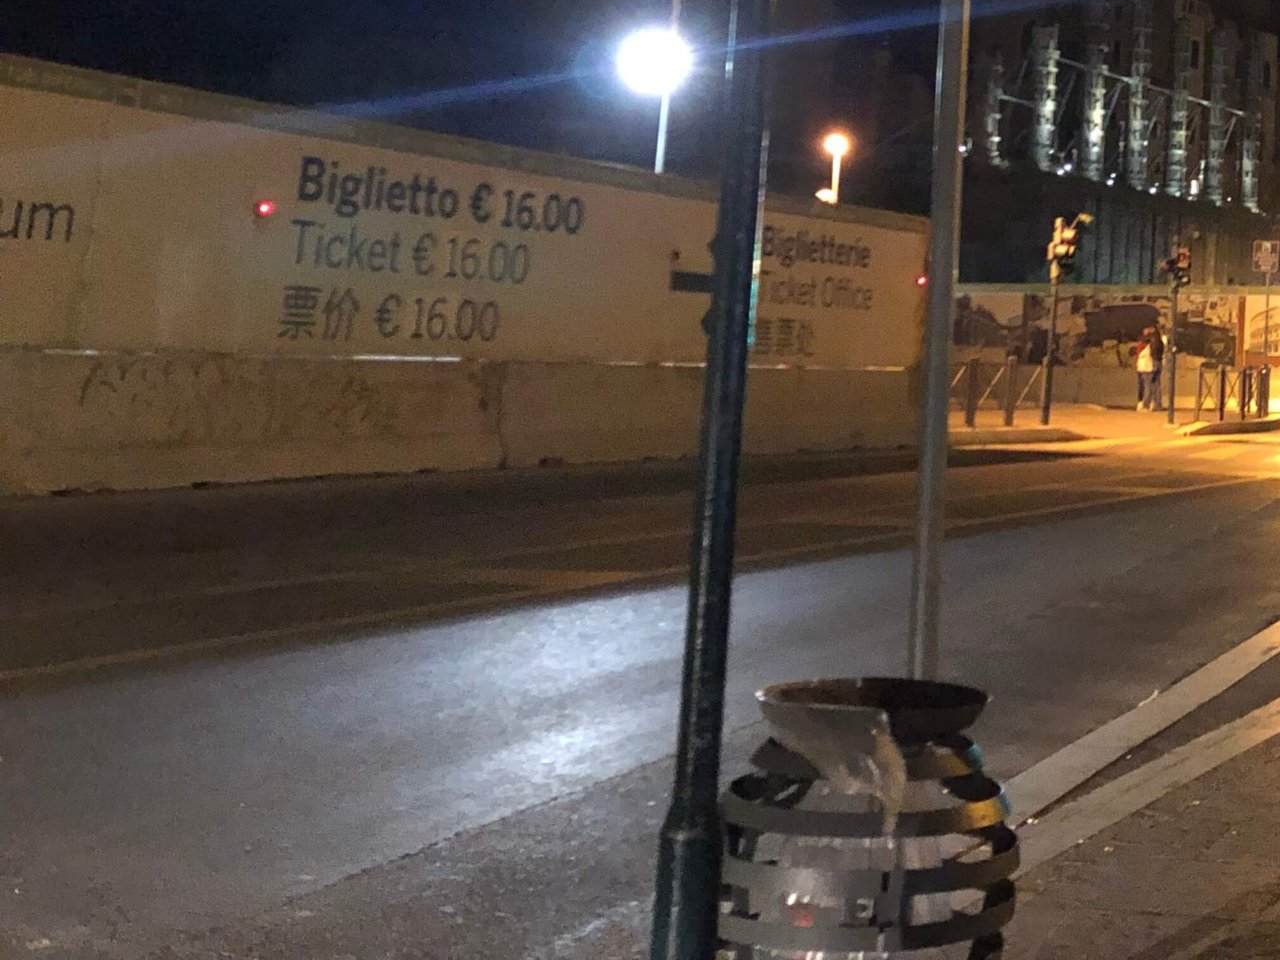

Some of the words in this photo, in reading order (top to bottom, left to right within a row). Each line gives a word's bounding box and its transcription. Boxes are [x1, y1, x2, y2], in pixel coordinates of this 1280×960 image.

[298, 155, 460, 220] Biglietto
[469, 182, 497, 223] €
[502, 189, 584, 235] 16.00
[290, 219, 400, 274] Ticket
[412, 232, 438, 277] €
[445, 237, 531, 285] 16.00
[276, 285, 362, 341] 票价
[375, 293, 402, 339] €
[410, 296, 500, 342] 16.00
